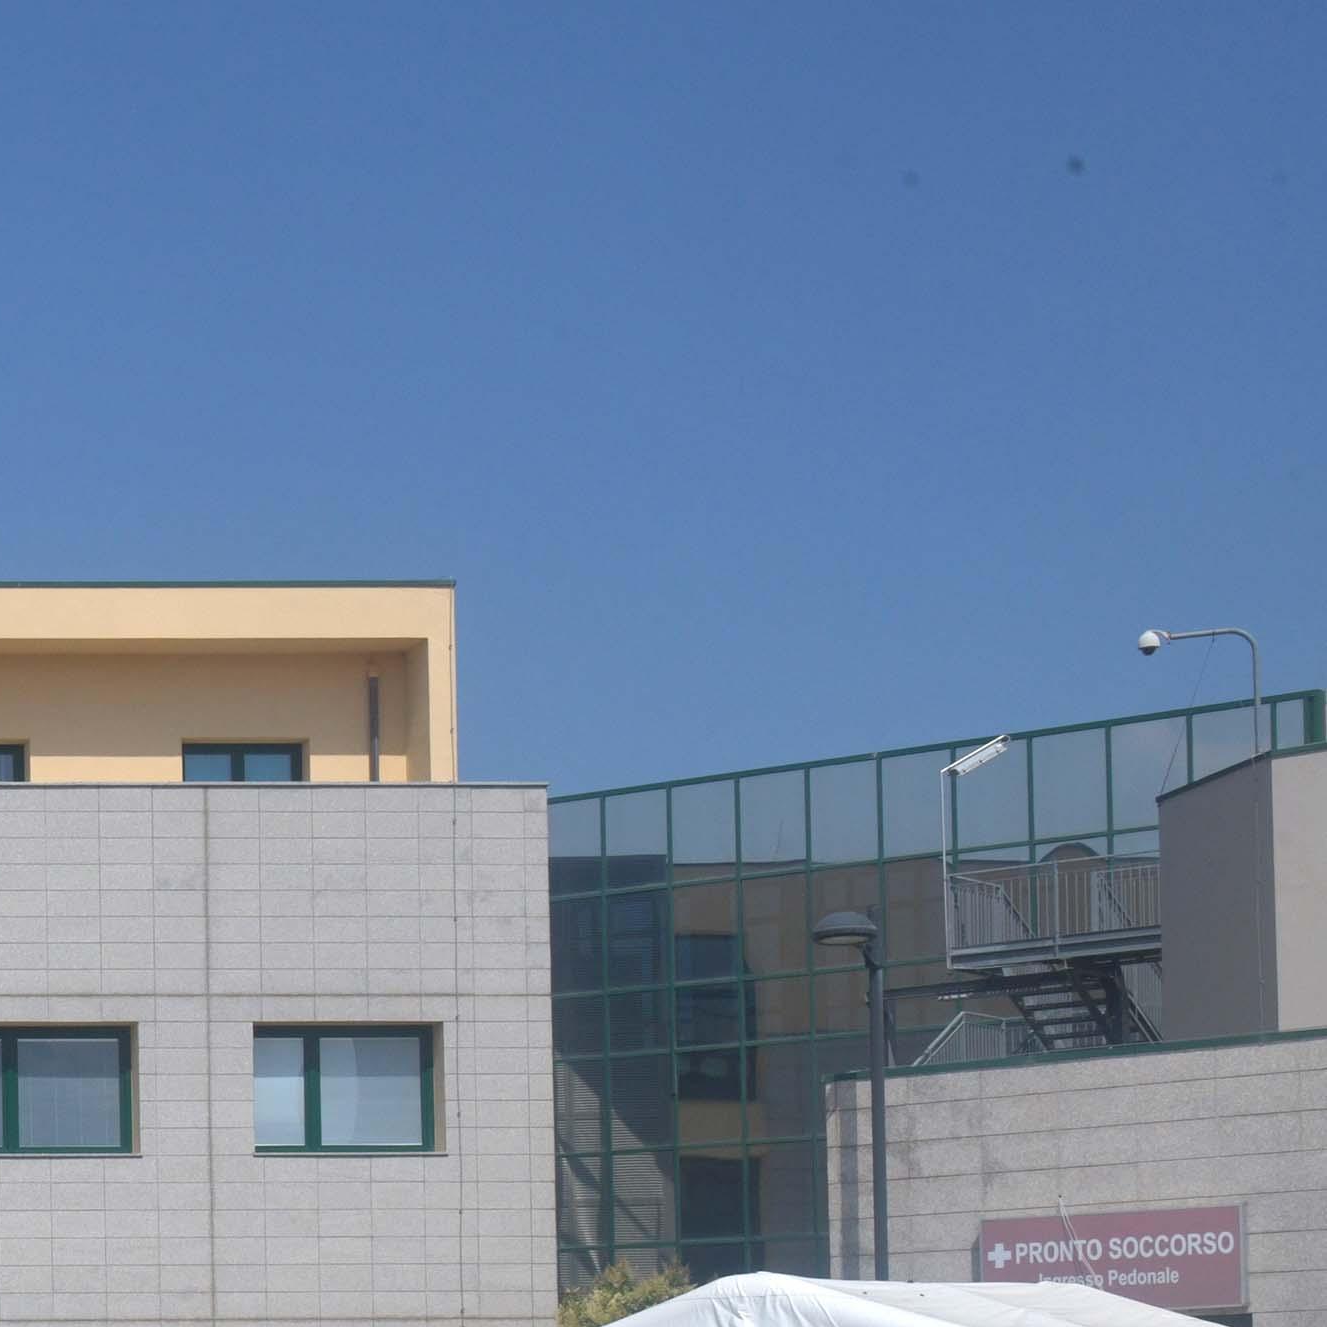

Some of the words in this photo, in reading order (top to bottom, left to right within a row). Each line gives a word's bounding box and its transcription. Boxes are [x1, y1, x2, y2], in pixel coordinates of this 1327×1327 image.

[1015, 1239, 1102, 1265] PRONTO
[1109, 1231, 1235, 1260] SOCCORSO
[1108, 1267, 1180, 1287] Pedonale
